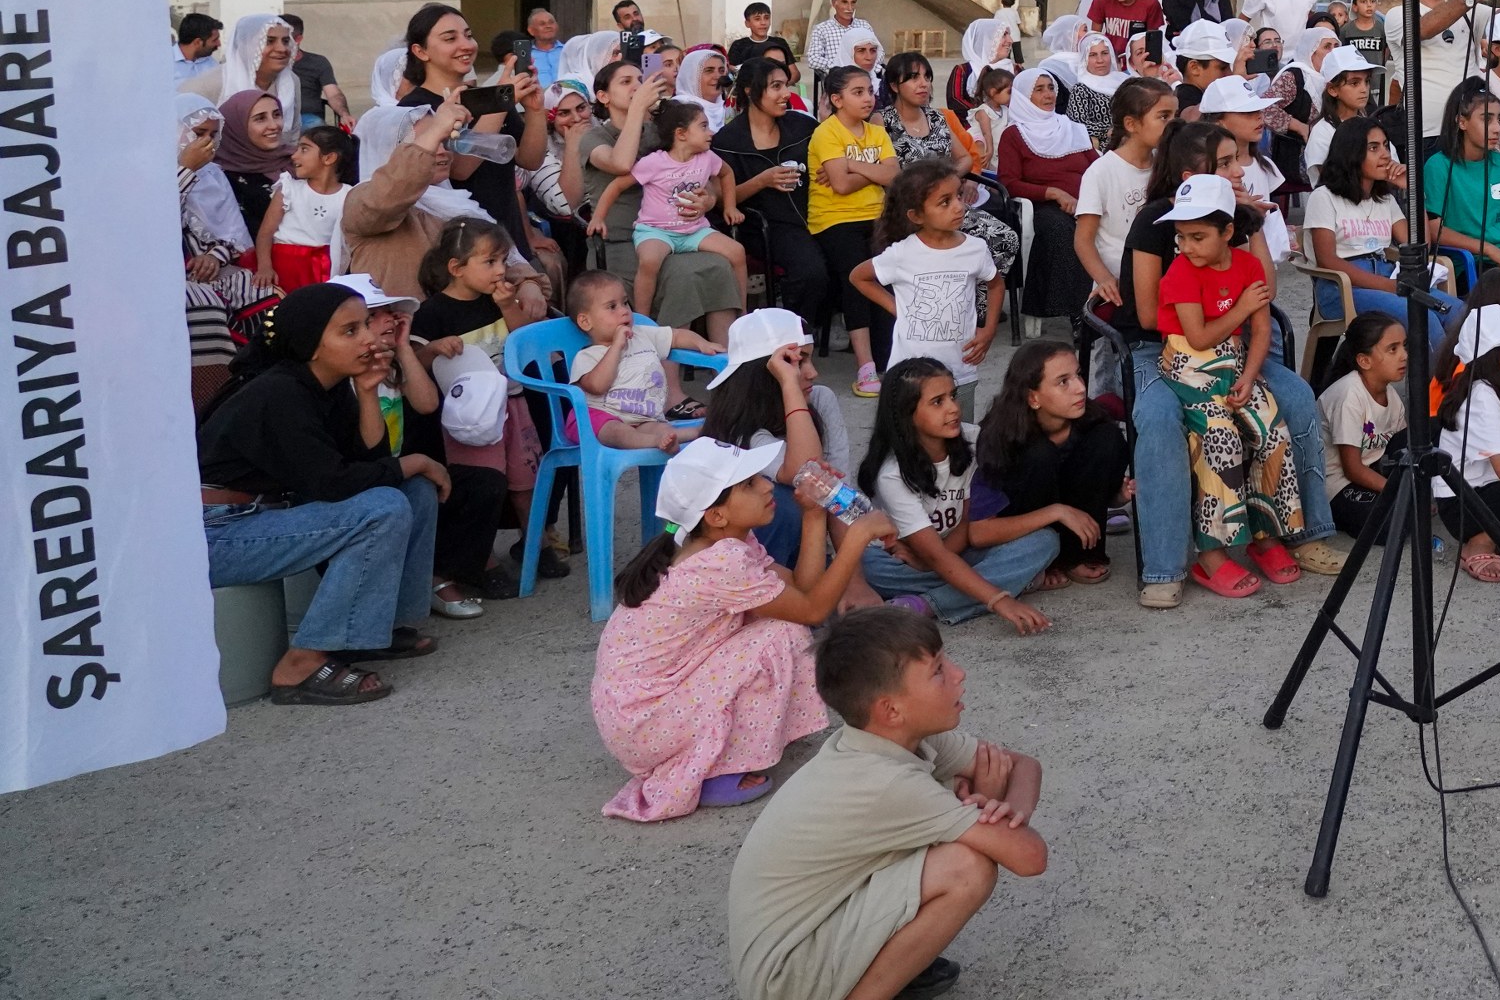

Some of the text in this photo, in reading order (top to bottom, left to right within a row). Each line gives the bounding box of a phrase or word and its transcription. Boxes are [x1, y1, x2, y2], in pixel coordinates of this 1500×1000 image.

[1349, 38, 1381, 51] STREET
[11, 283, 121, 711] ŞAREDARIYA
[928, 507, 957, 532] 98
